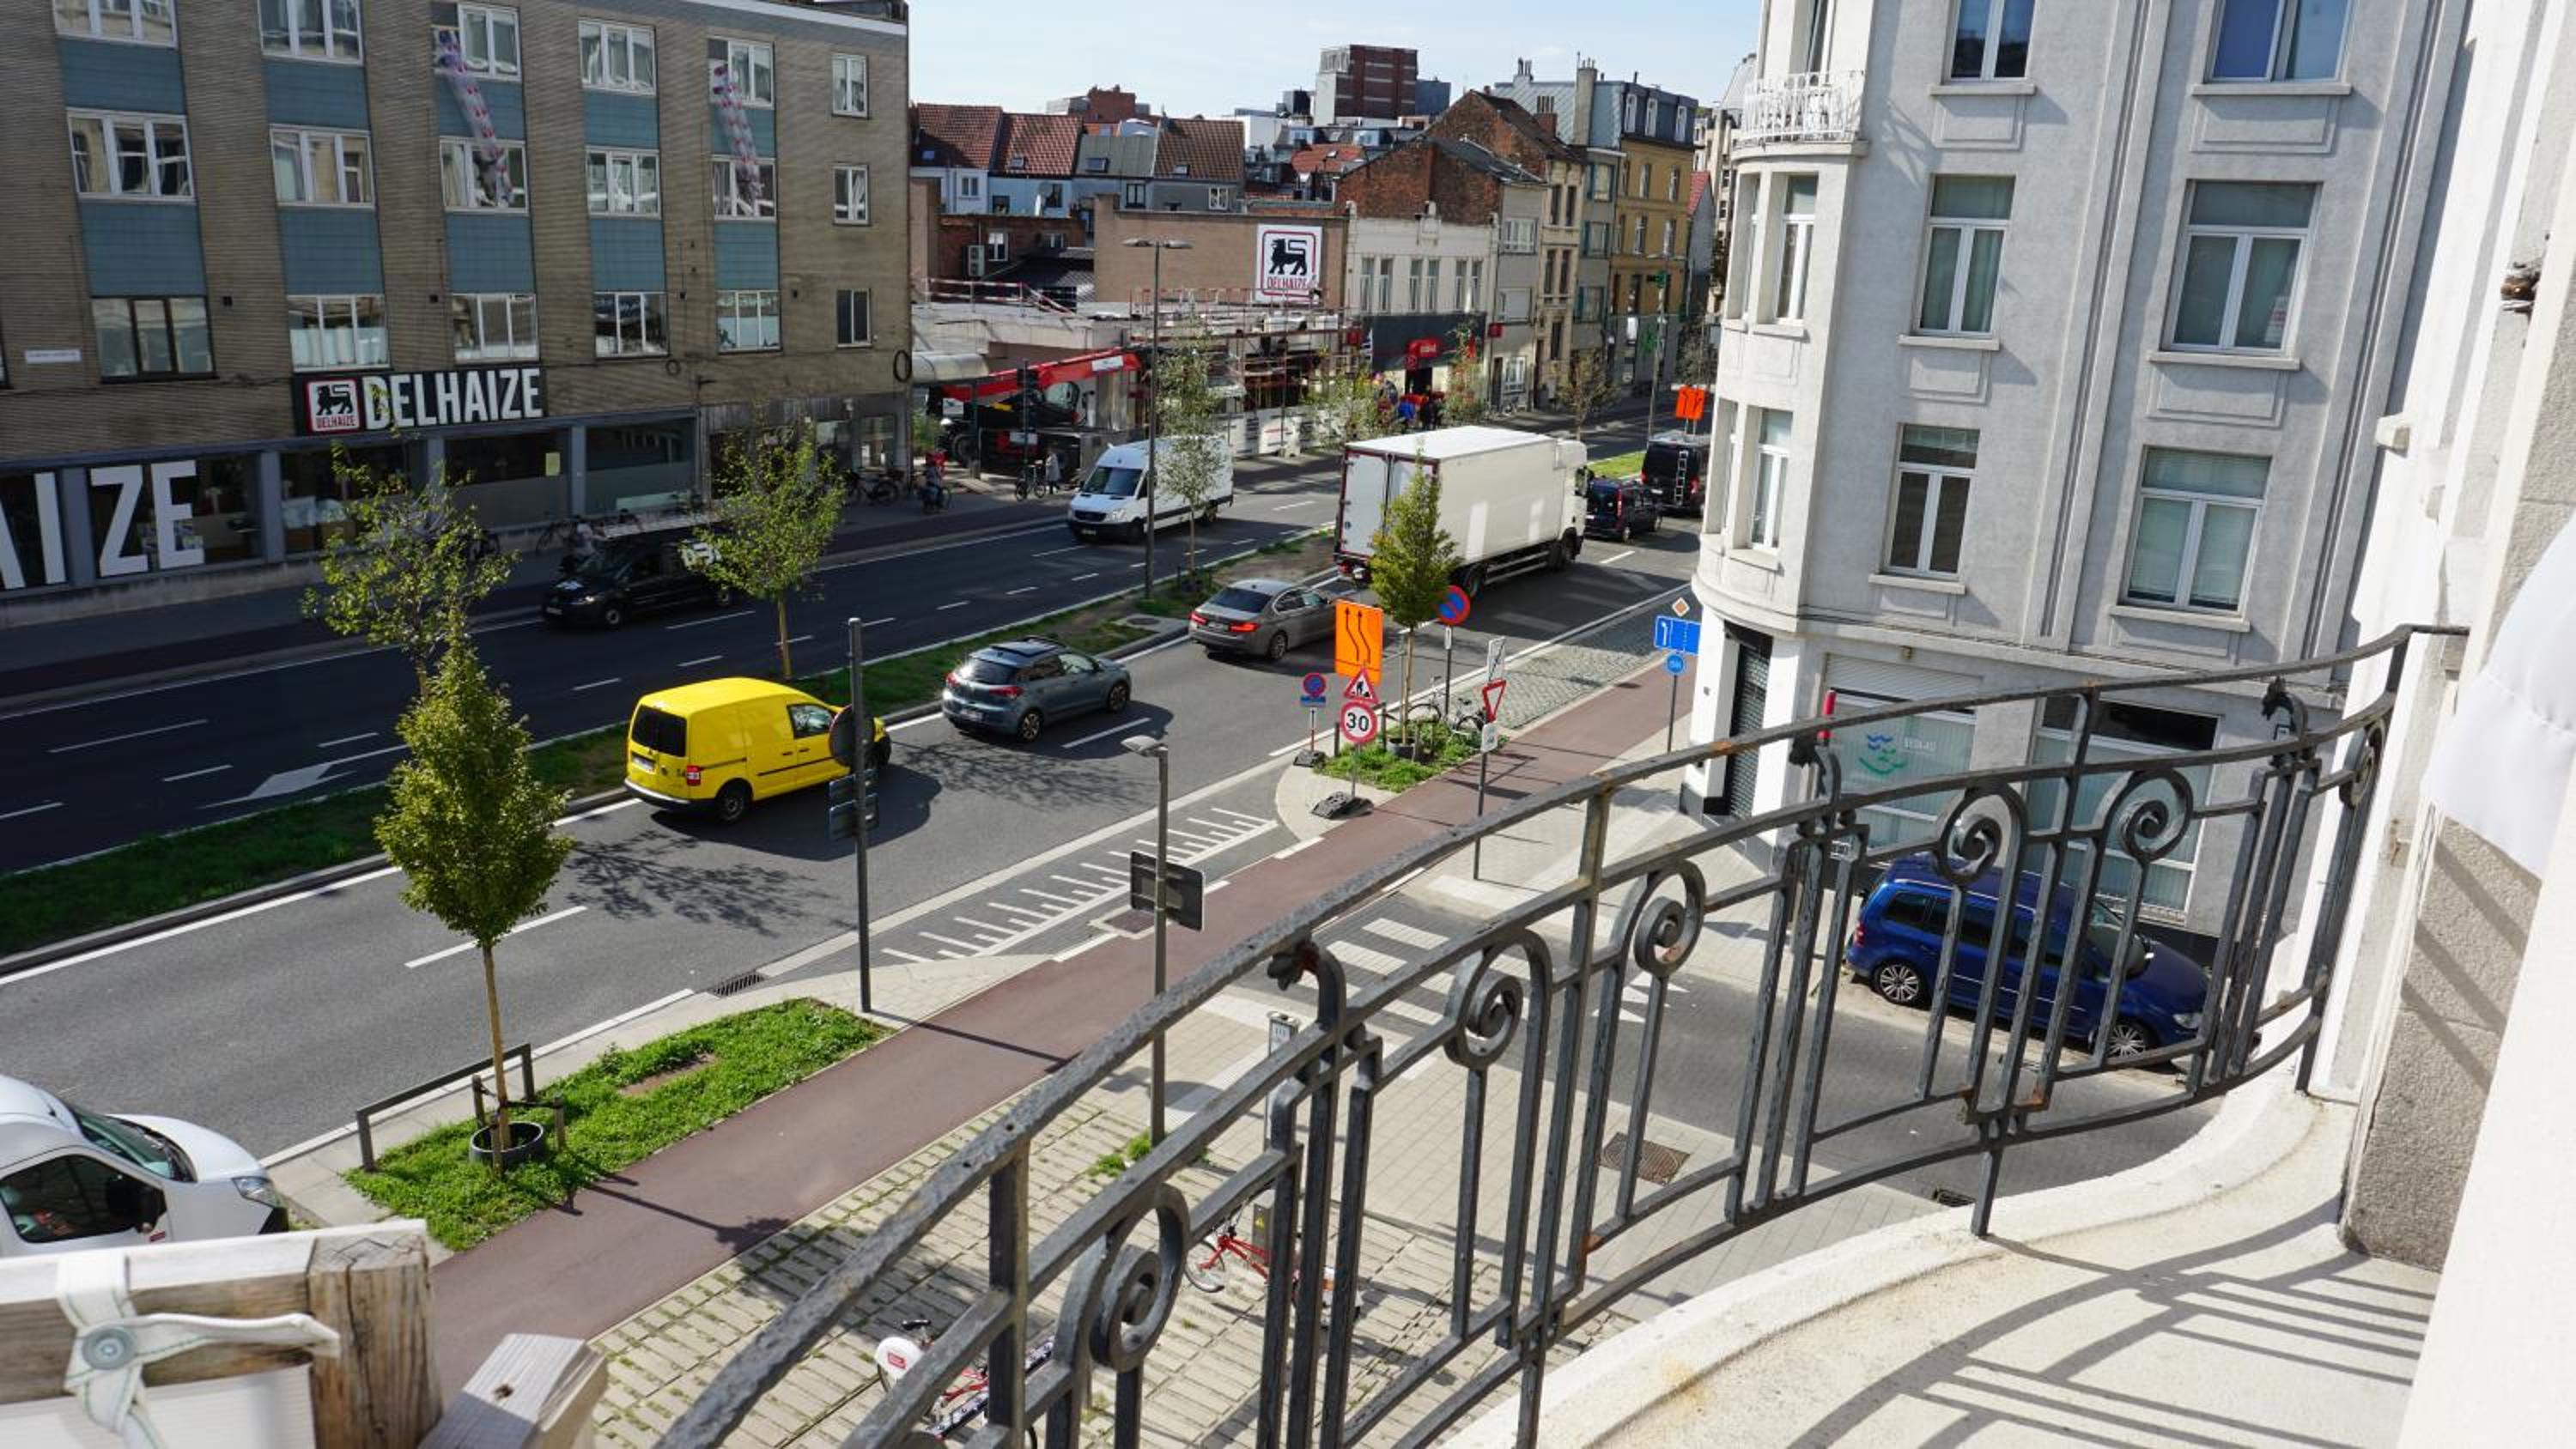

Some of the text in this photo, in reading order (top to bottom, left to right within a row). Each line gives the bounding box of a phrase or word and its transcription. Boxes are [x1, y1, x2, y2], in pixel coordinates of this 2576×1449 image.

[362, 368, 543, 429] DELHAIZE
[316, 415, 357, 428] DELHAIZE
[1346, 712, 1369, 731] 30
